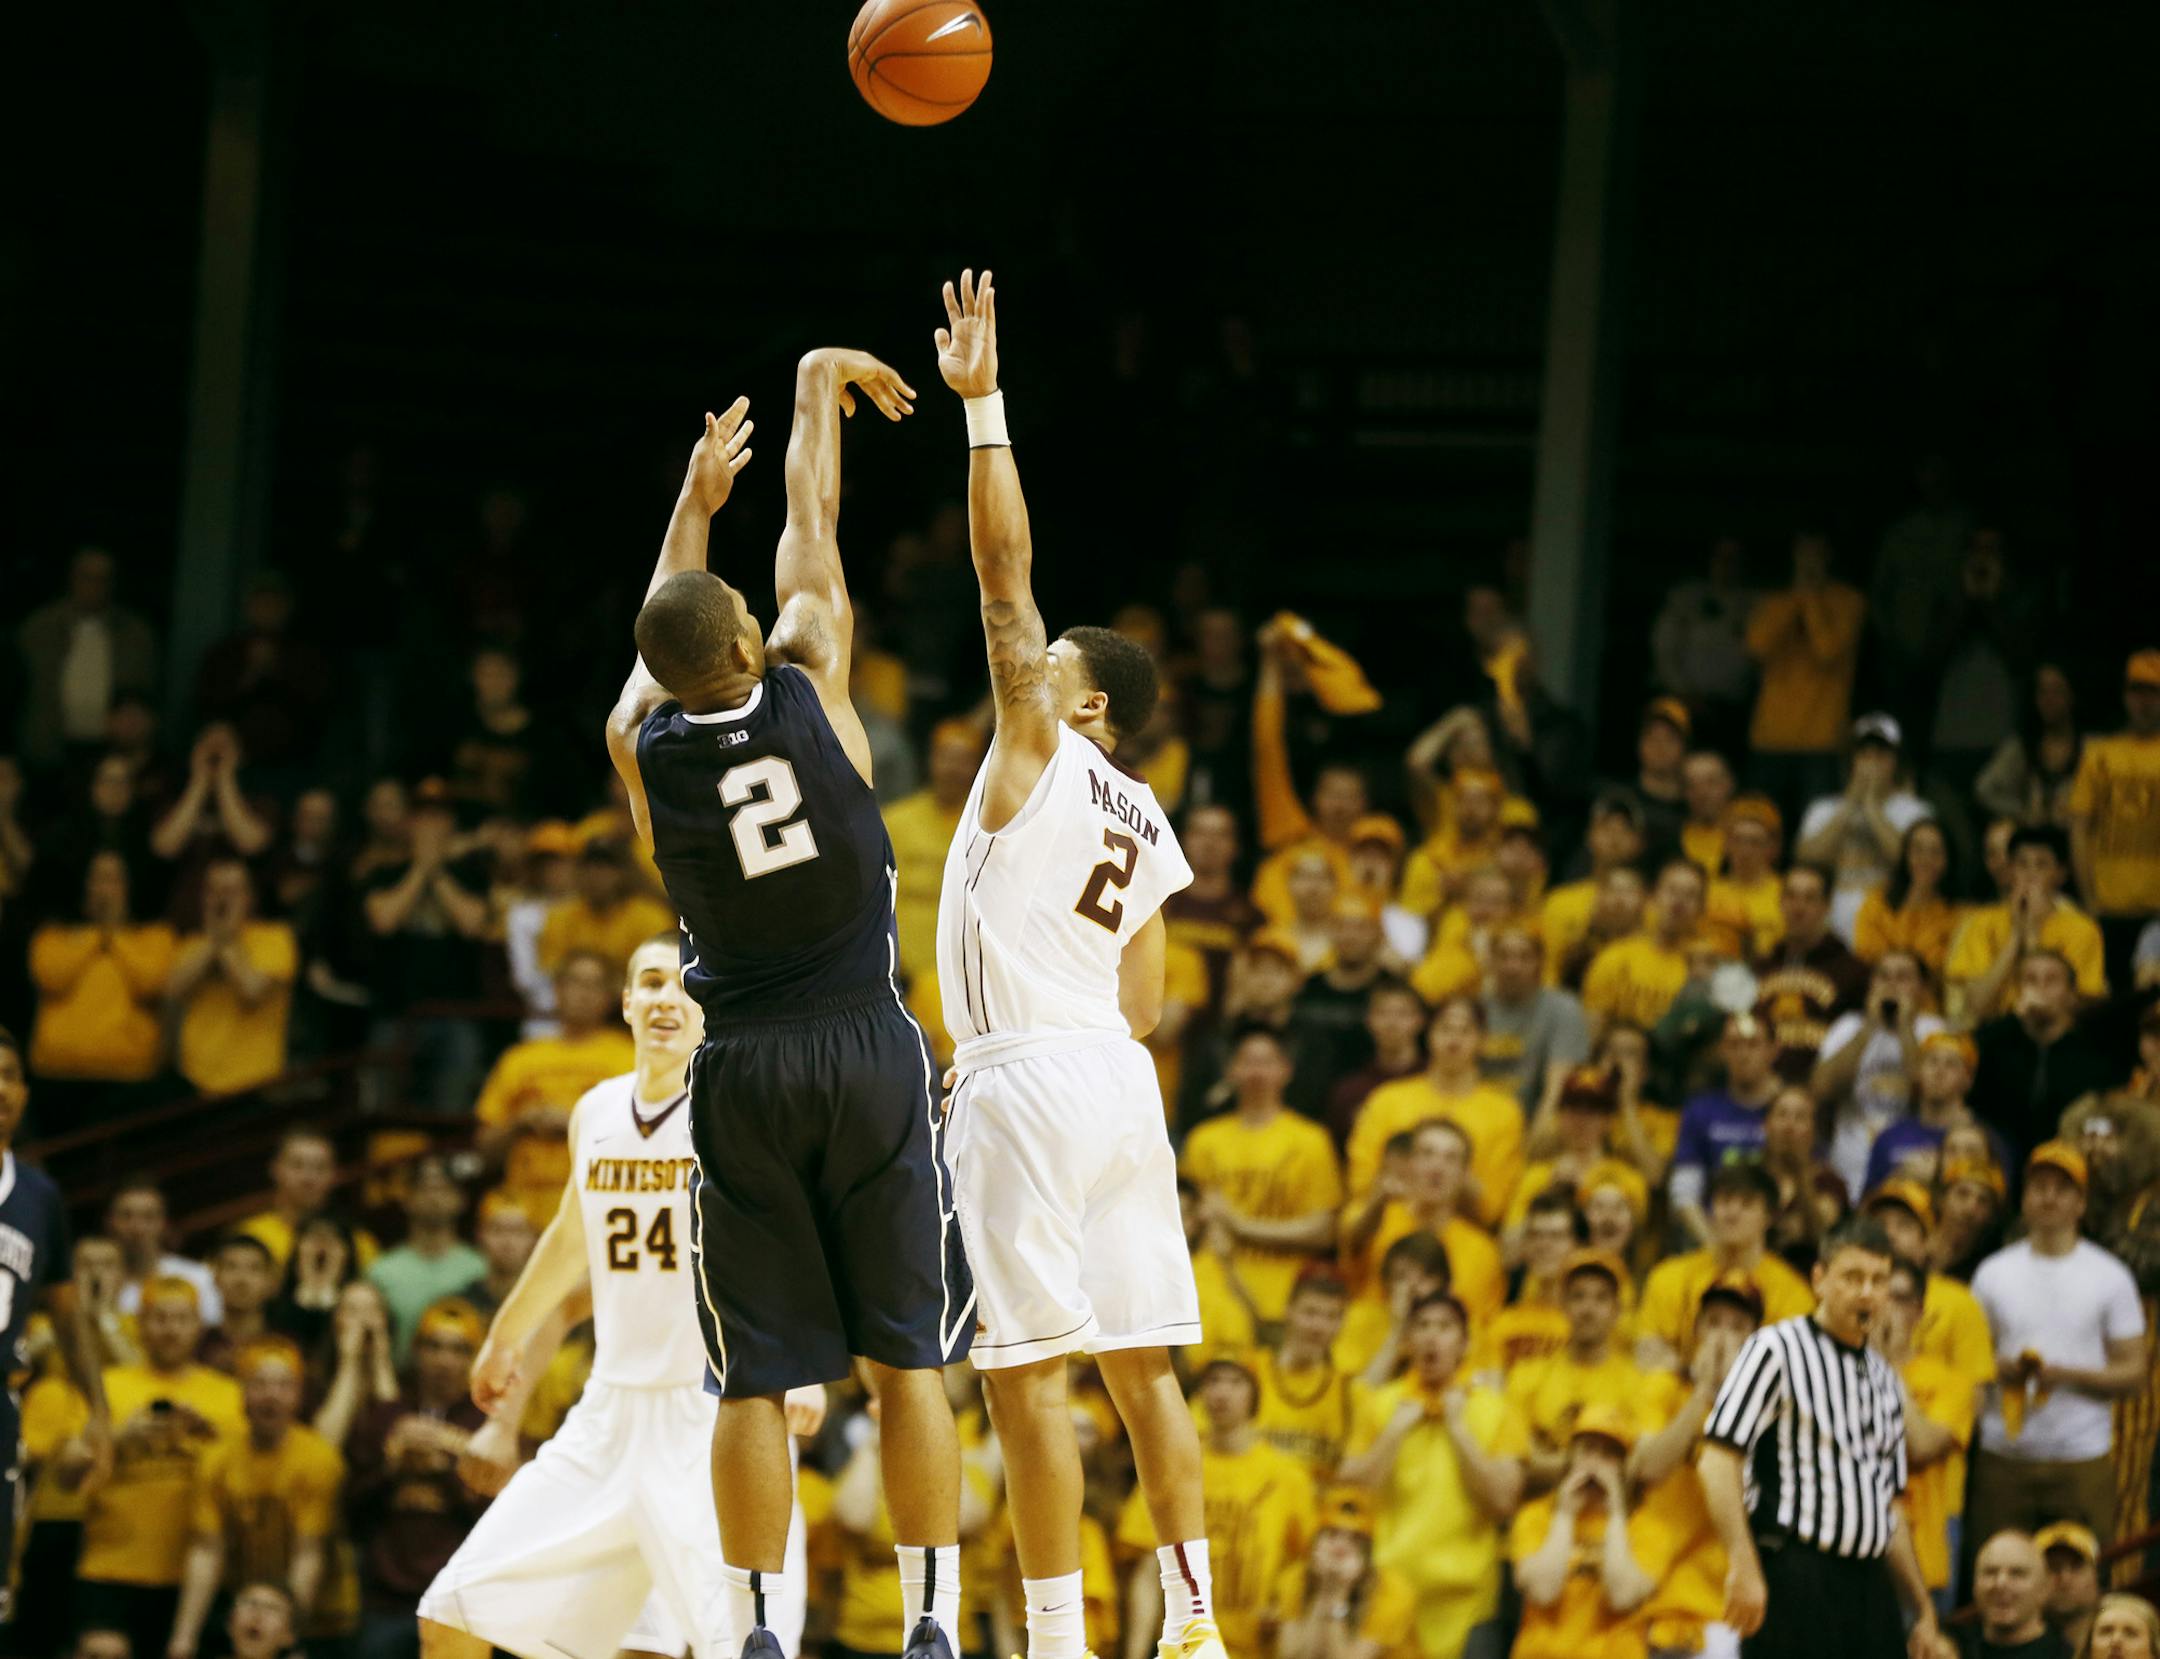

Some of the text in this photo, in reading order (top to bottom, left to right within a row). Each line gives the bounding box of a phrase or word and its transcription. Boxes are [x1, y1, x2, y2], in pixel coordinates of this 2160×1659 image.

[717, 755, 820, 880] 2
[1088, 768, 1160, 847] MASON
[1073, 827, 1139, 935] 2
[606, 1207, 678, 1272] 24
